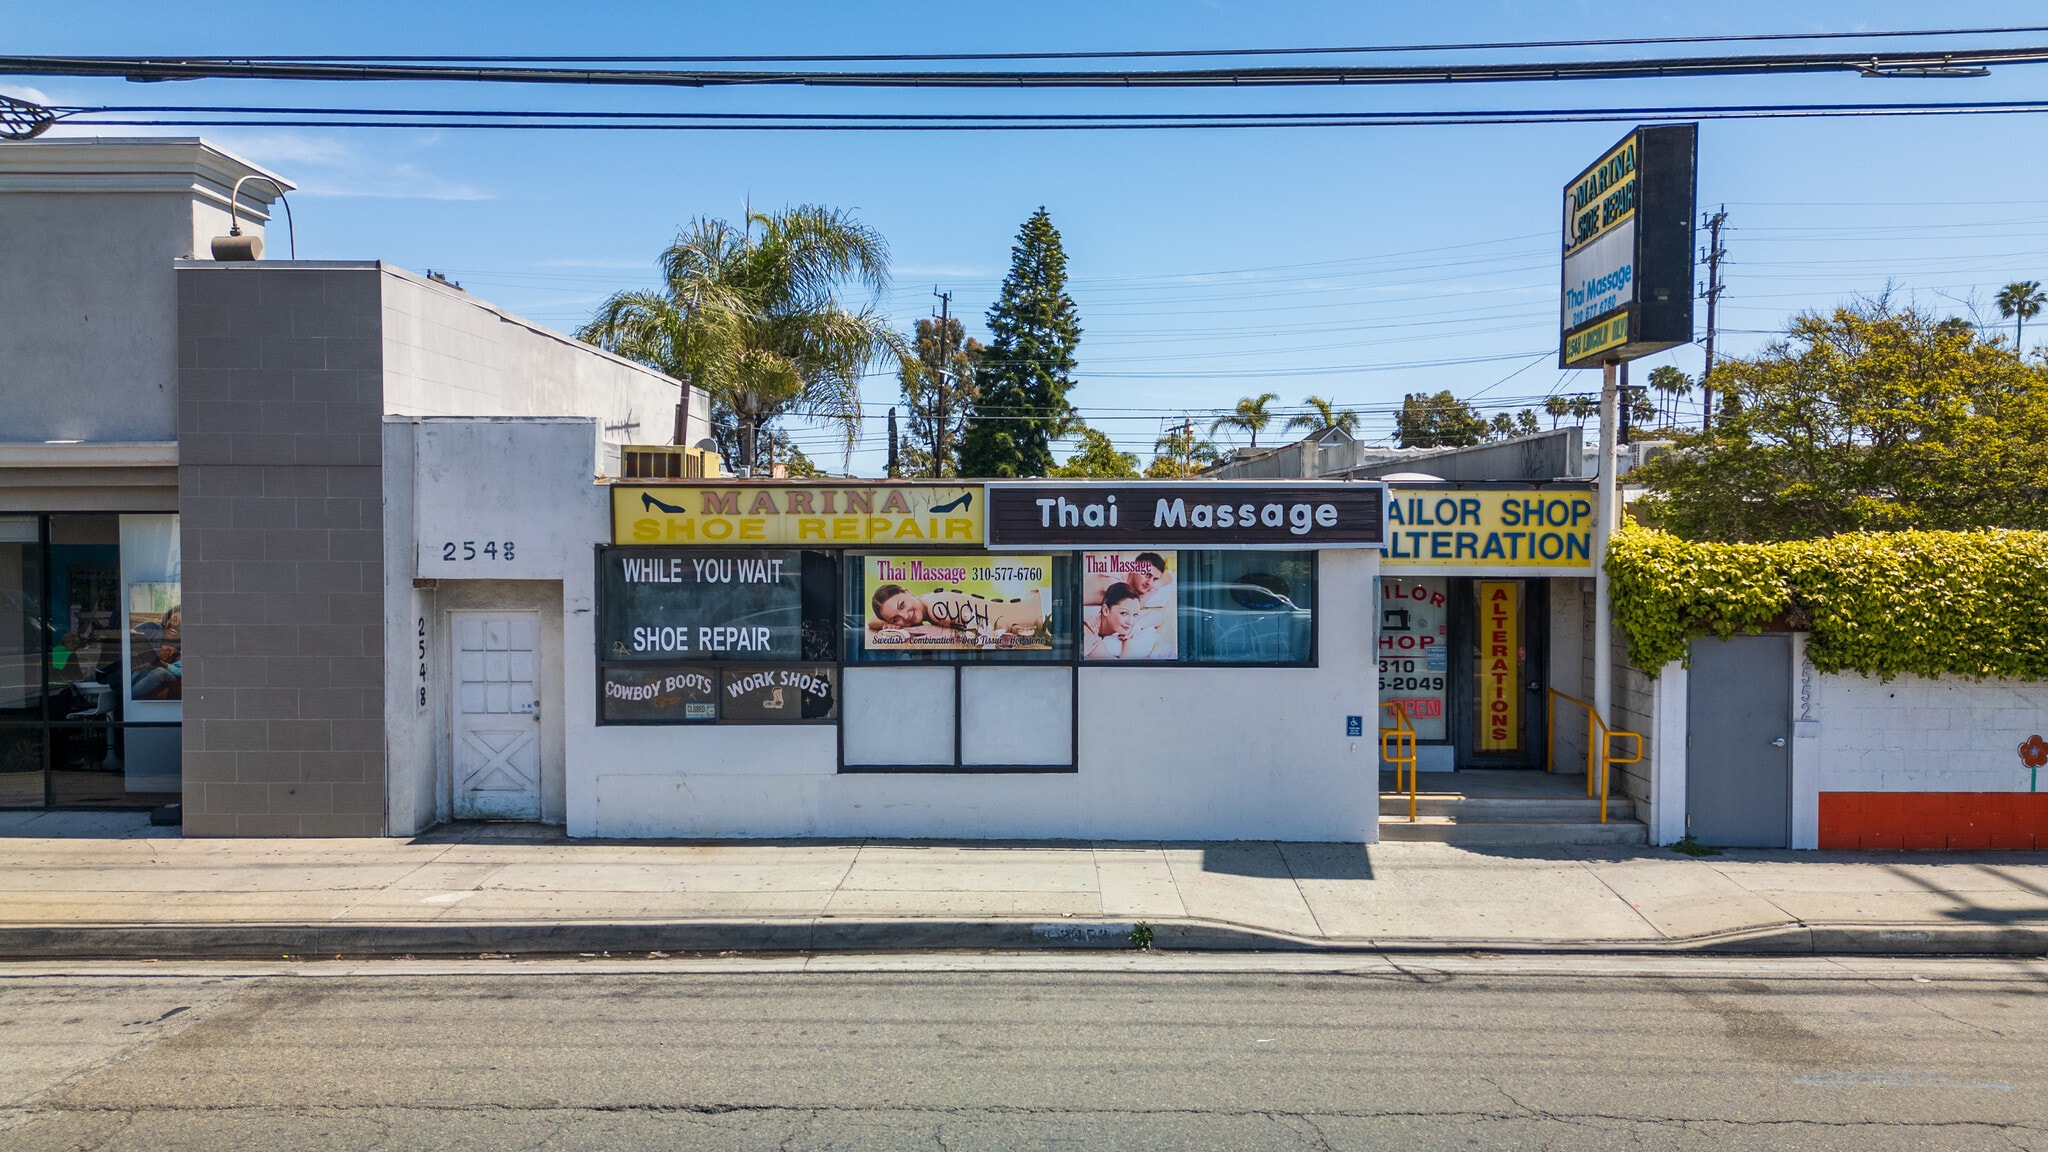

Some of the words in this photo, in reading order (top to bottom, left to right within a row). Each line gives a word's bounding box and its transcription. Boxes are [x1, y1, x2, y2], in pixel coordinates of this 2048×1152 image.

[1575, 144, 1636, 212] MARINA
[1577, 204, 1600, 244] SHOE
[1602, 179, 1636, 228] REPAIR
[1566, 280, 1585, 310] Thai
[1587, 264, 1632, 302] Massage
[700, 490, 912, 515] MARINA
[1035, 495, 1118, 528] Thai
[1153, 497, 1338, 534] Massage
[1501, 499, 1591, 526] SHOP
[632, 518, 766, 540] SHOE
[799, 518, 974, 540] REPAIR
[443, 541, 516, 561] 2548
[623, 559, 682, 583] WHILE
[693, 559, 732, 583] YOU
[738, 559, 783, 583] WAIT
[877, 560, 907, 581] Thai
[910, 561, 966, 583] Massage
[972, 567, 1042, 581] 310-577-6760
[1086, 555, 1107, 573] Thai
[1110, 555, 1152, 575] Massage
[932, 601, 989, 626] OUCH
[633, 627, 688, 651] SHOE
[699, 627, 771, 651] REPAIR
[872, 635, 904, 645] Swedish
[909, 635, 955, 645] Combination
[418, 617, 427, 707] 2548
[1491, 589, 1508, 741] ALTERATIONS
[605, 680, 661, 701] COWBOY
[665, 673, 712, 694] BOOTS
[727, 671, 775, 698] WORK
[780, 670, 829, 698] SHOES
[1390, 700, 1440, 716] OPEN
